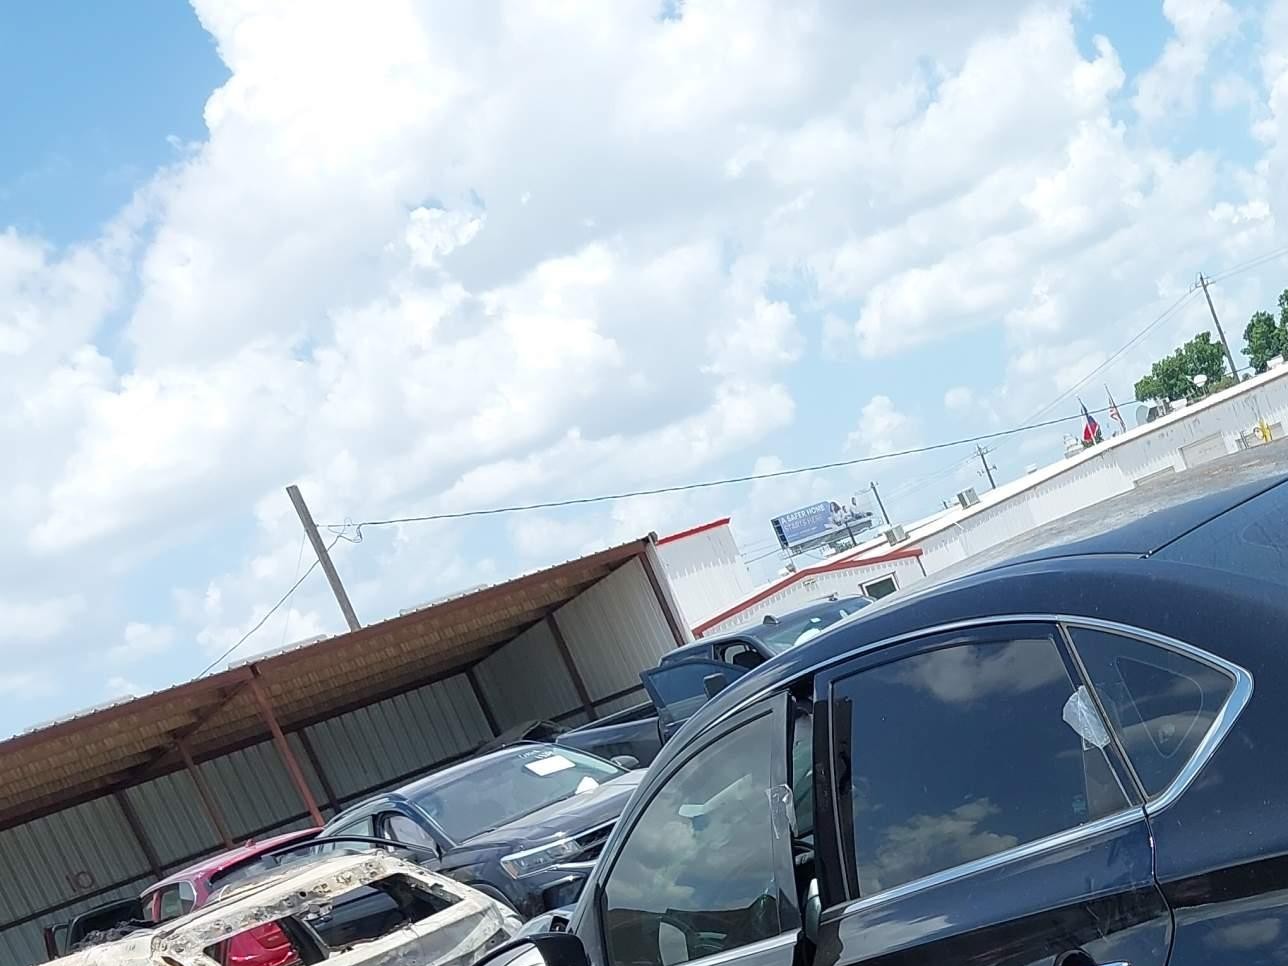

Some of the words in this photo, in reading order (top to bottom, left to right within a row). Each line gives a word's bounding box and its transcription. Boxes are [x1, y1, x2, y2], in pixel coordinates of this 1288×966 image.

[780, 516, 786, 524] A
[786, 511, 806, 522] SAFER
[806, 504, 825, 516] HOME
